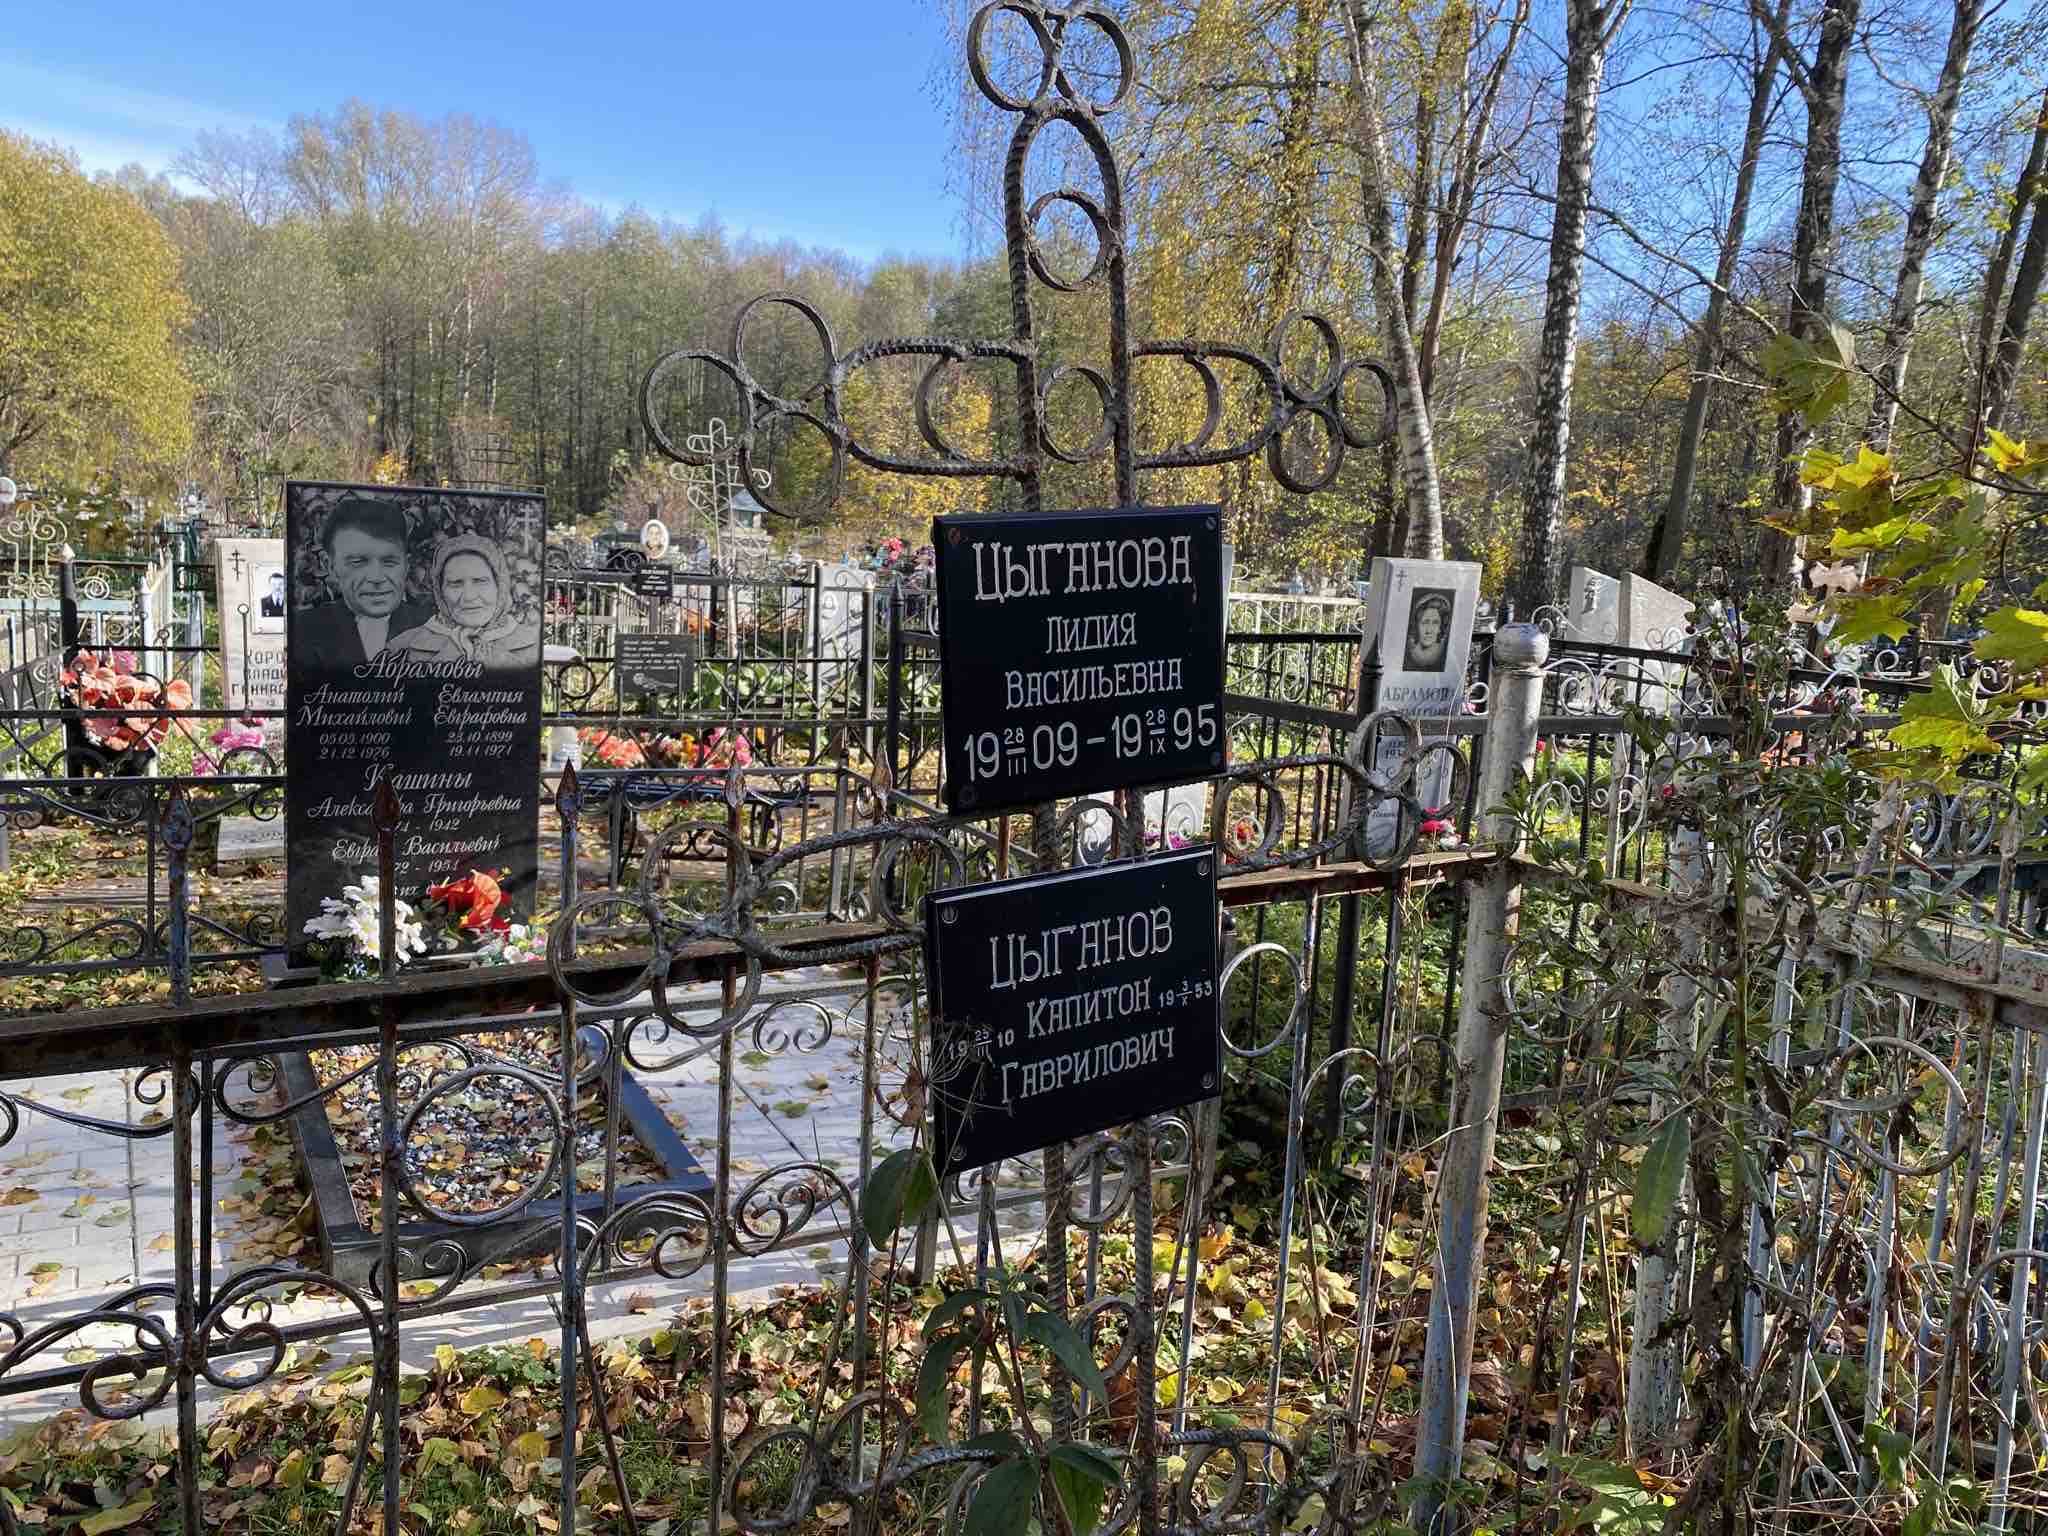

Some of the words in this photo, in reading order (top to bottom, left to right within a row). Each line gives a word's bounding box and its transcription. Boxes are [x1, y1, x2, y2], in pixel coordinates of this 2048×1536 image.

[972, 535, 1193, 603] ЦЫГАНОВА
[1045, 612, 1137, 655] ЛИДИЯ
[353, 650, 484, 687] Абрамовы
[1004, 658, 1184, 711] ВАСИЛЬЕВНА
[303, 682, 405, 704] Анатолий
[438, 683, 525, 704] Евлампия
[296, 704, 415, 727] Михайлович
[433, 704, 528, 729] Евграфовна
[306, 796, 414, 819] Алексара
[423, 792, 522, 821] Григорьевна
[401, 834, 502, 857] Васильевич
[988, 905, 1173, 990] ЦЫГАНОВ
[1027, 976, 1151, 1039] КАПИТОН
[1001, 1027, 1176, 1103] ГАВРИЛОВИЧ
